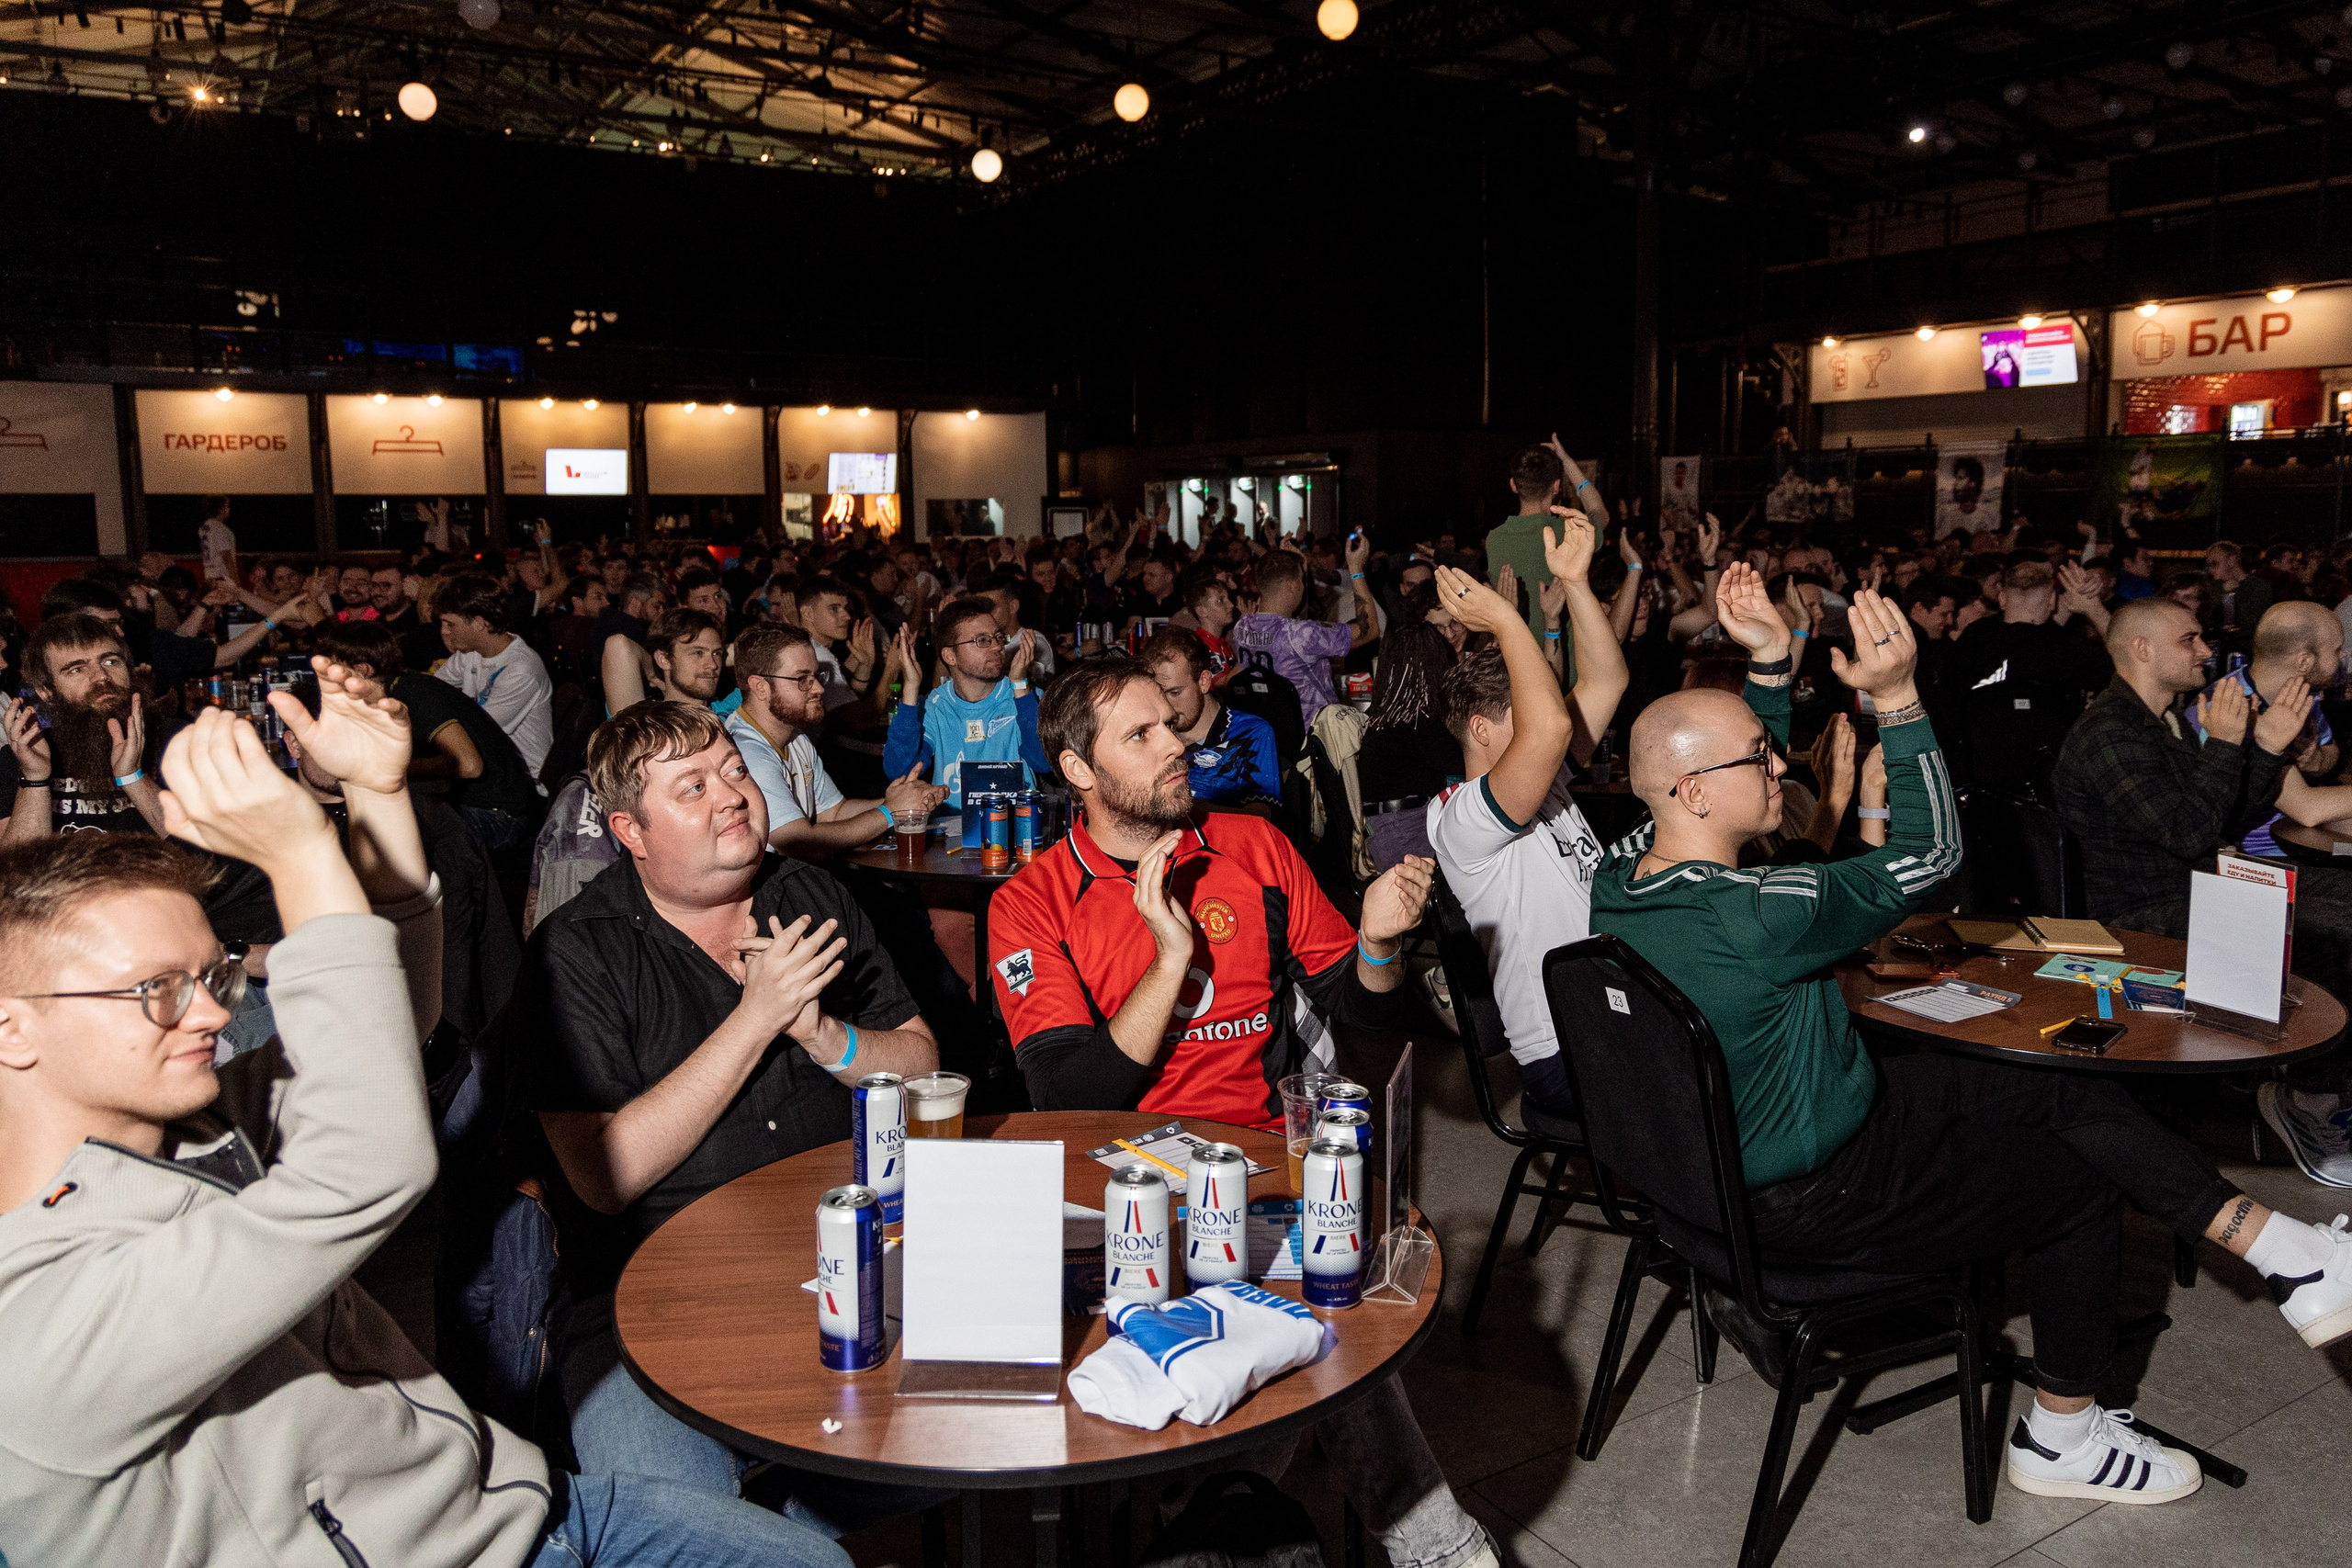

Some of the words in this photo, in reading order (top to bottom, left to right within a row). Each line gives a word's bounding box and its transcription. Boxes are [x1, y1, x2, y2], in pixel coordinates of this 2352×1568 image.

[2188, 312, 2292, 357] БАР
[164, 433, 287, 452] ГАРДЕРОБ
[75, 798, 108, 815] MY
[2227, 863, 2275, 879] ЗАКАЗЫВАЙТЕ
[2245, 875, 2277, 886] НАПИТКИ
[1200, 903, 1228, 919] MANCHESTER
[1210, 929, 1231, 938] UNITED
[876, 1126, 907, 1145] KRO
[887, 1141, 905, 1152] BLAN
[884, 1199, 904, 1208] WHEA
[1308, 1197, 1363, 1219] KRONE
[1187, 1203, 1241, 1226] KRONE
[1317, 1217, 1357, 1228] BLANCHE
[1193, 1224, 1232, 1236] BLANCHE
[1106, 1229, 1164, 1251] KRONE
[1113, 1250, 1155, 1261] BLANCHE
[1313, 1281, 1340, 1291] WHEAT
